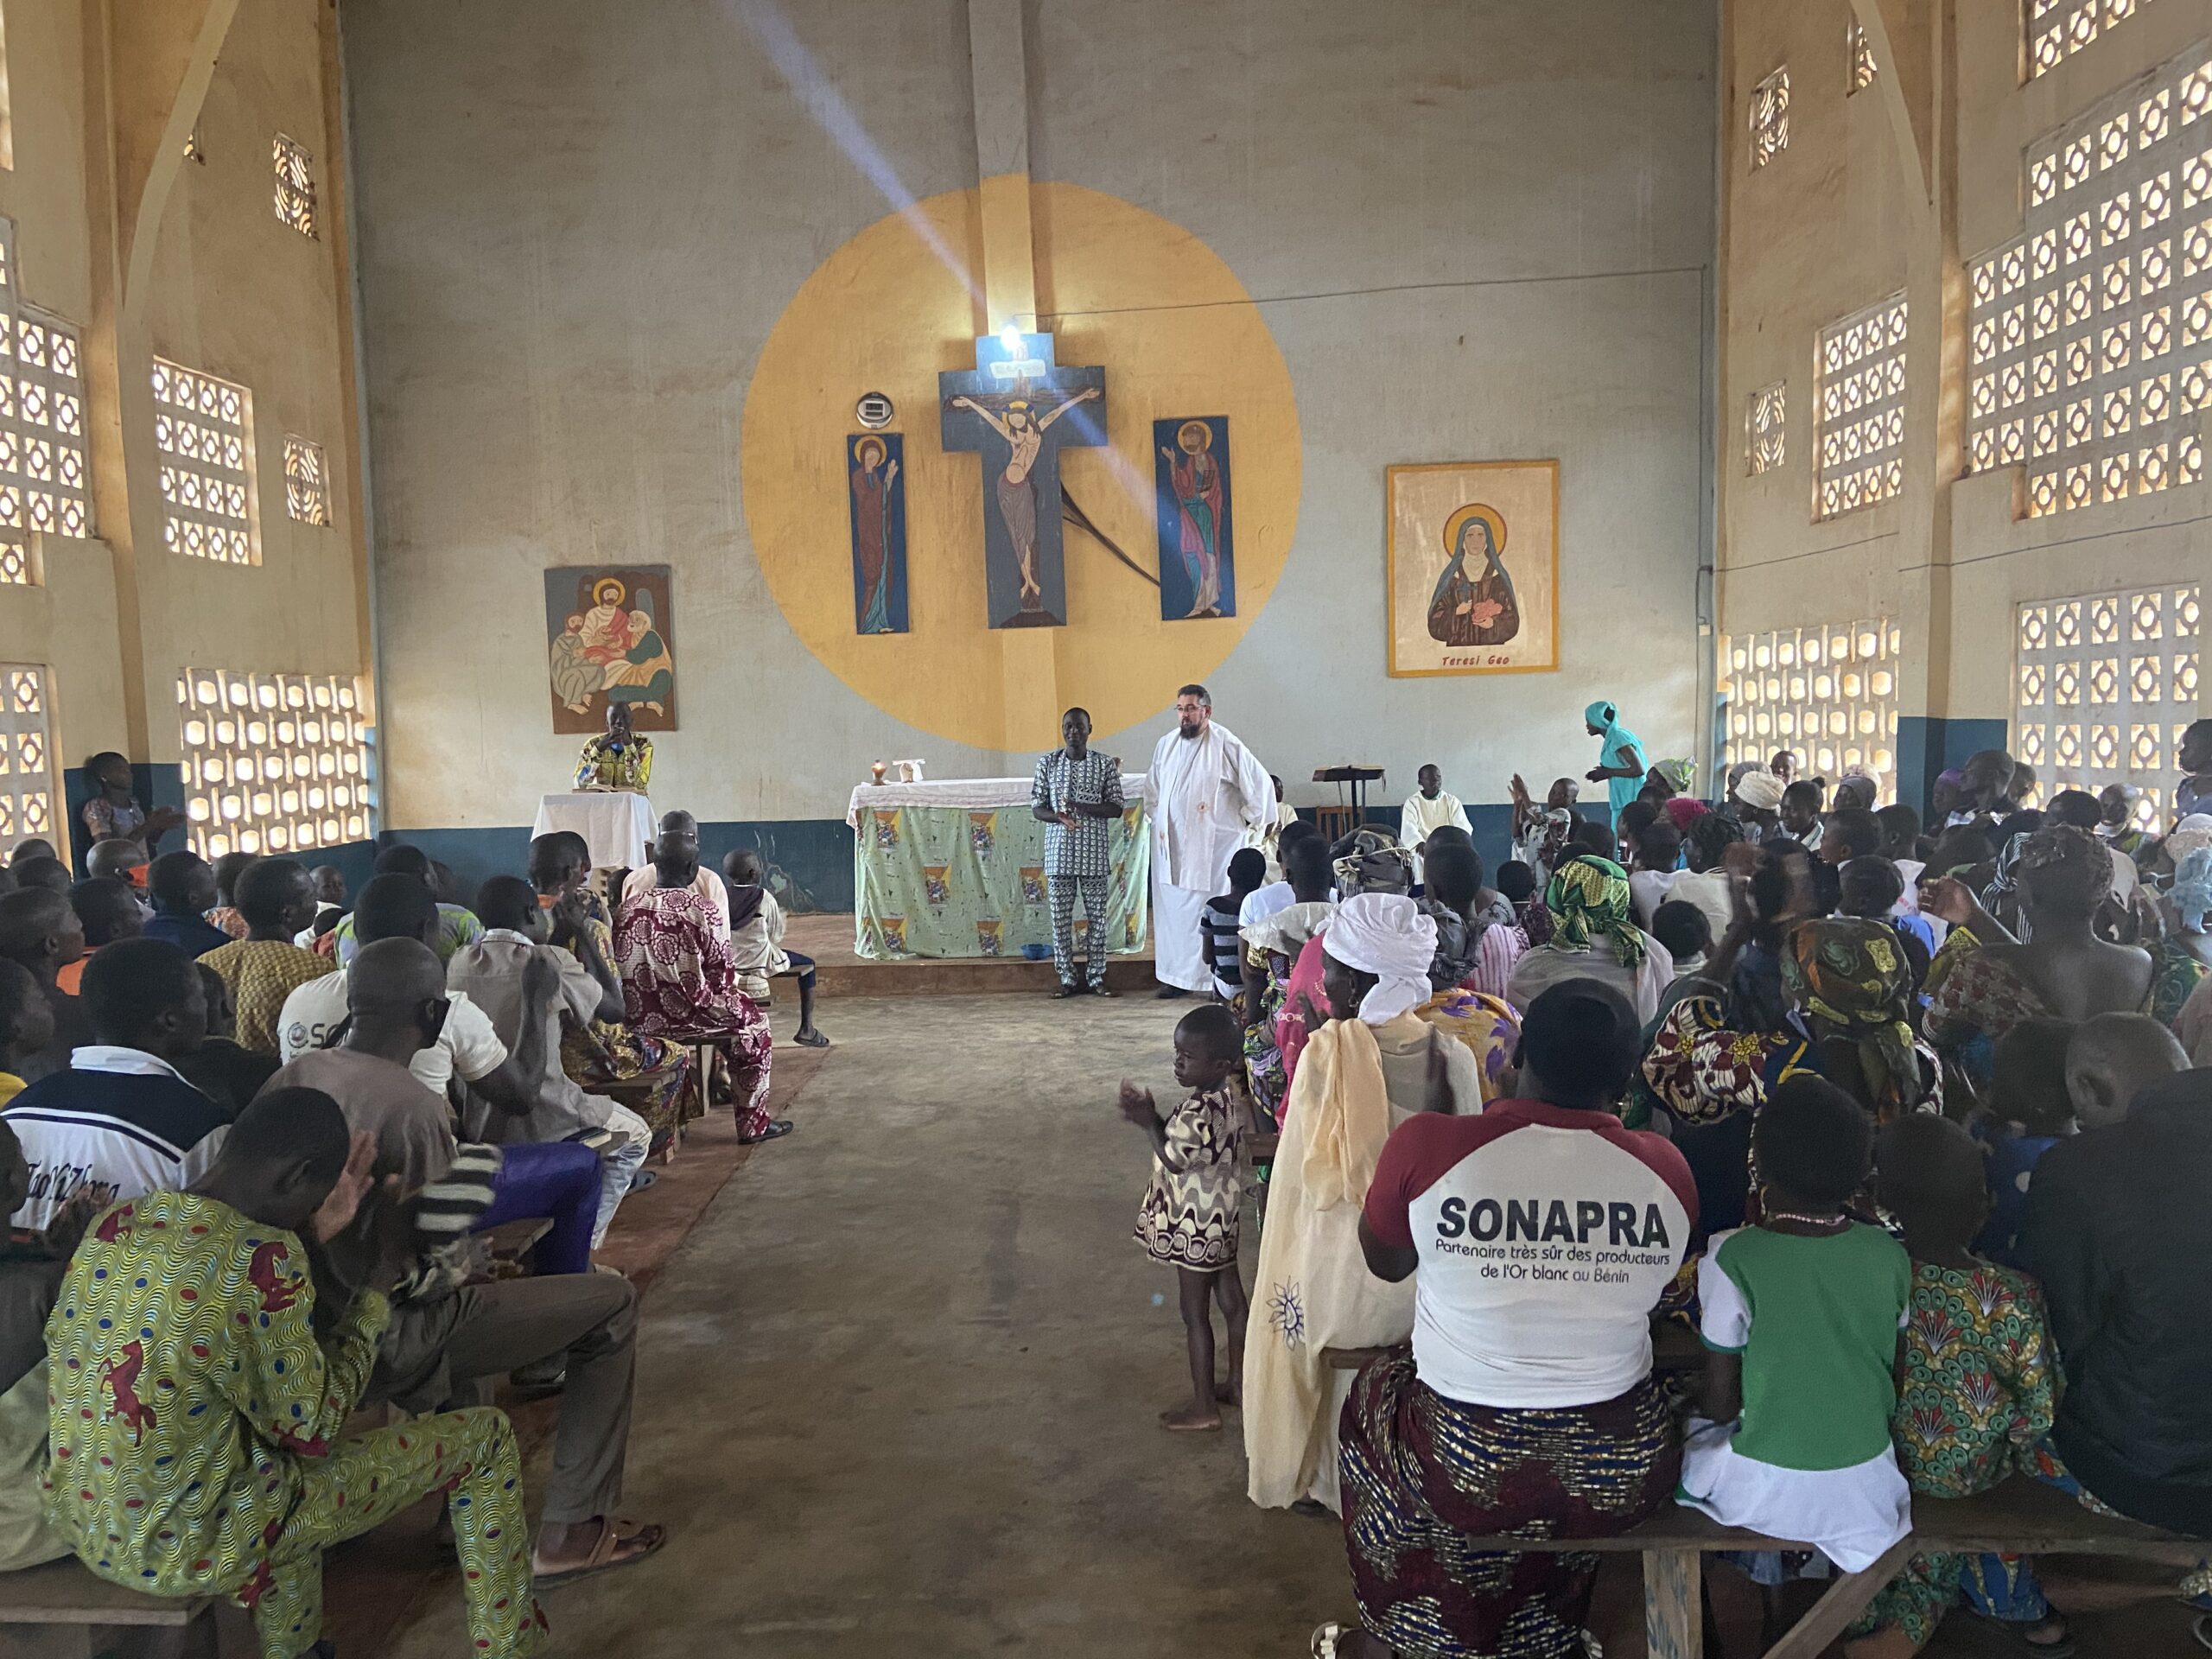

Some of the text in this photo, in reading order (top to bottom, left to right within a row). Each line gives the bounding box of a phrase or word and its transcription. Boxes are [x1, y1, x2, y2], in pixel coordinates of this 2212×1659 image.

[1442, 655, 1510, 666] Teresi Geo
[1436, 1196, 1670, 1249] SONAPRA
[1435, 1238, 1670, 1266] Partenaire très sûr des producteurs
[1480, 1262, 1630, 1283] de l'Or blanc au Bénin
